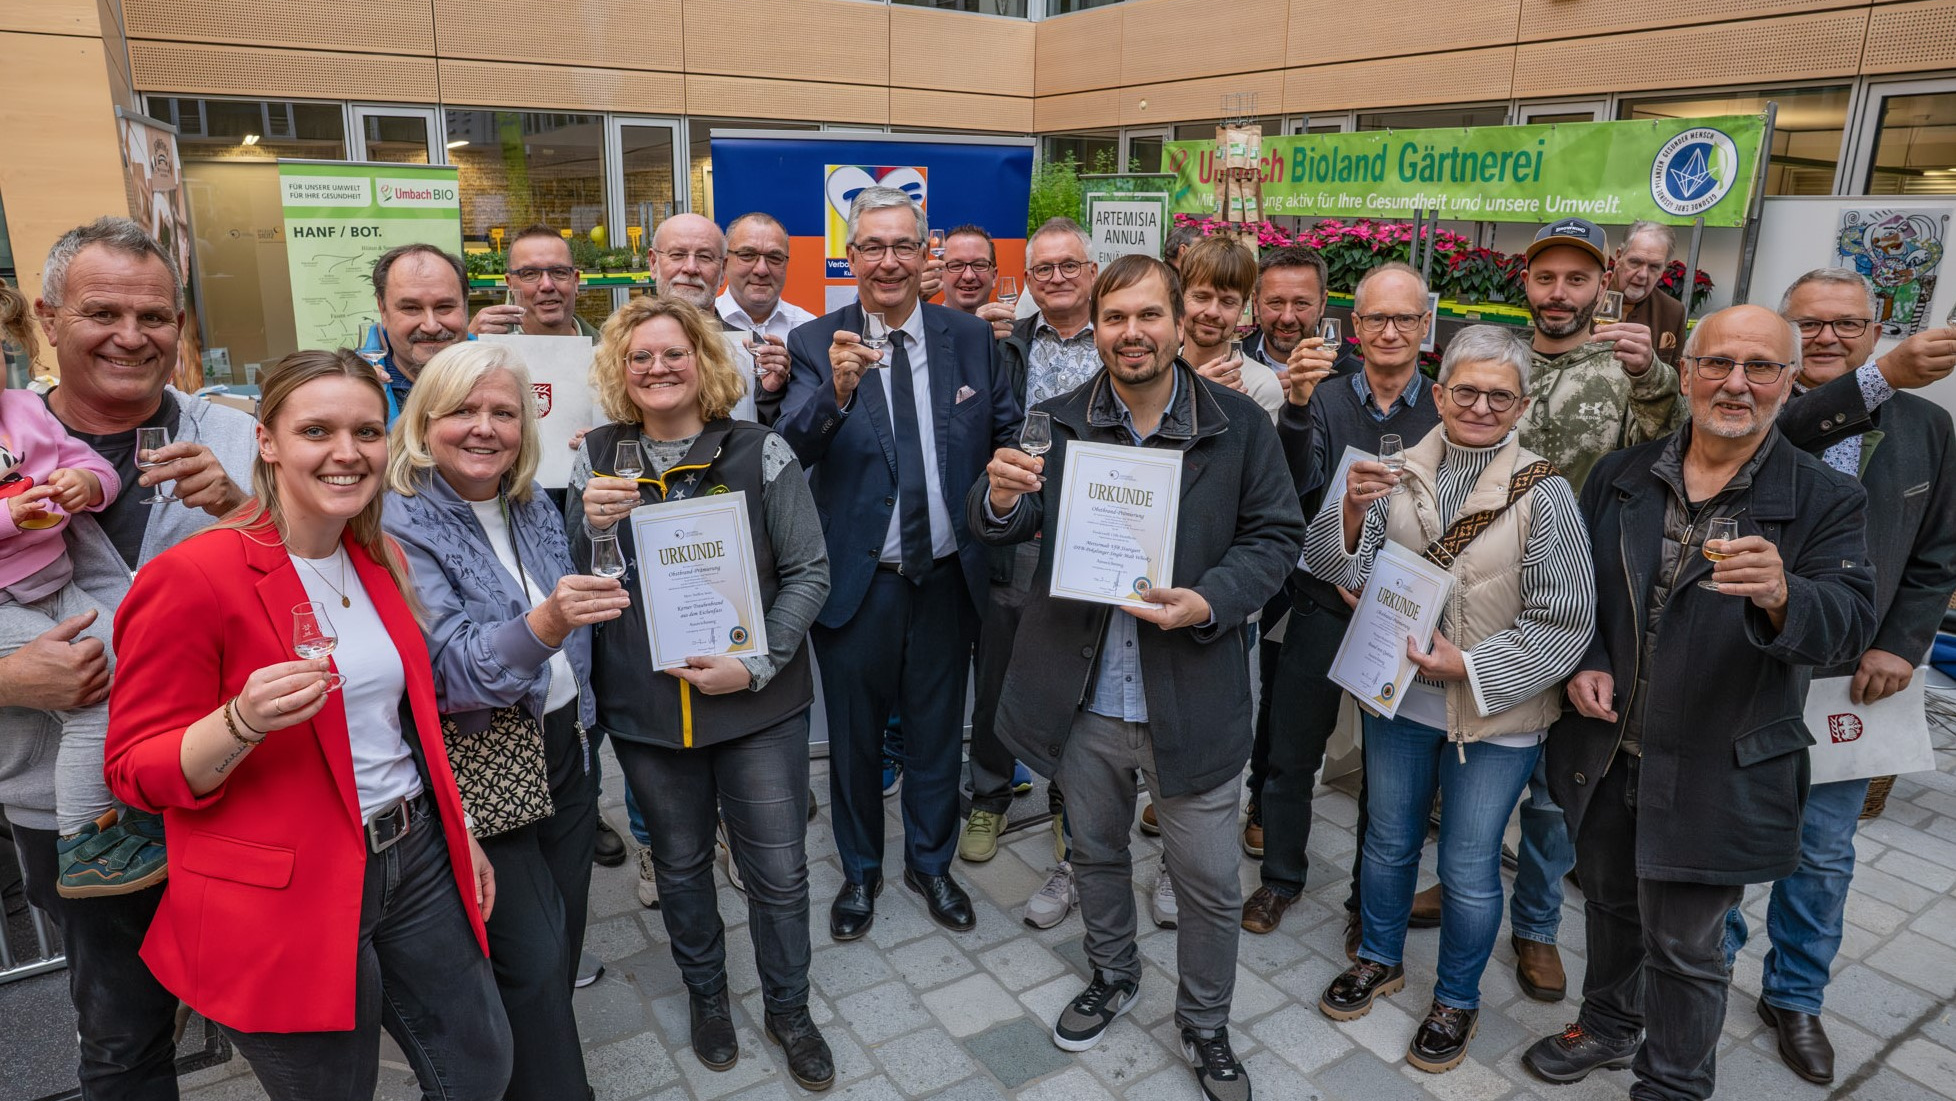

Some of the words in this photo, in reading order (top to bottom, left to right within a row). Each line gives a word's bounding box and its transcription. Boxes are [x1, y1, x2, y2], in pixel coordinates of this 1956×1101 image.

[1662, 135, 1688, 158] GESUNDER
[1690, 131, 1714, 140] MENSCH
[1291, 143, 1388, 183] Bioland
[1399, 139, 1545, 183] Gärtnerei
[1285, 192, 1314, 208] aktiv
[1317, 193, 1335, 208] für
[1338, 193, 1362, 209] Ihre
[1366, 193, 1447, 210] Gesundheit
[1451, 193, 1482, 211] und
[1485, 197, 1539, 212] unsere
[1545, 195, 1622, 214] Umwelt.
[293, 226, 336, 238] HANF
[350, 226, 382, 238] BOT.
[1096, 211, 1156, 227] ARTEMISIA
[1104, 229, 1145, 245] ANNUA
[1088, 482, 1154, 508] URKUNDE
[659, 540, 725, 566] URKUNDE
[1376, 587, 1421, 621] URKUNDE
